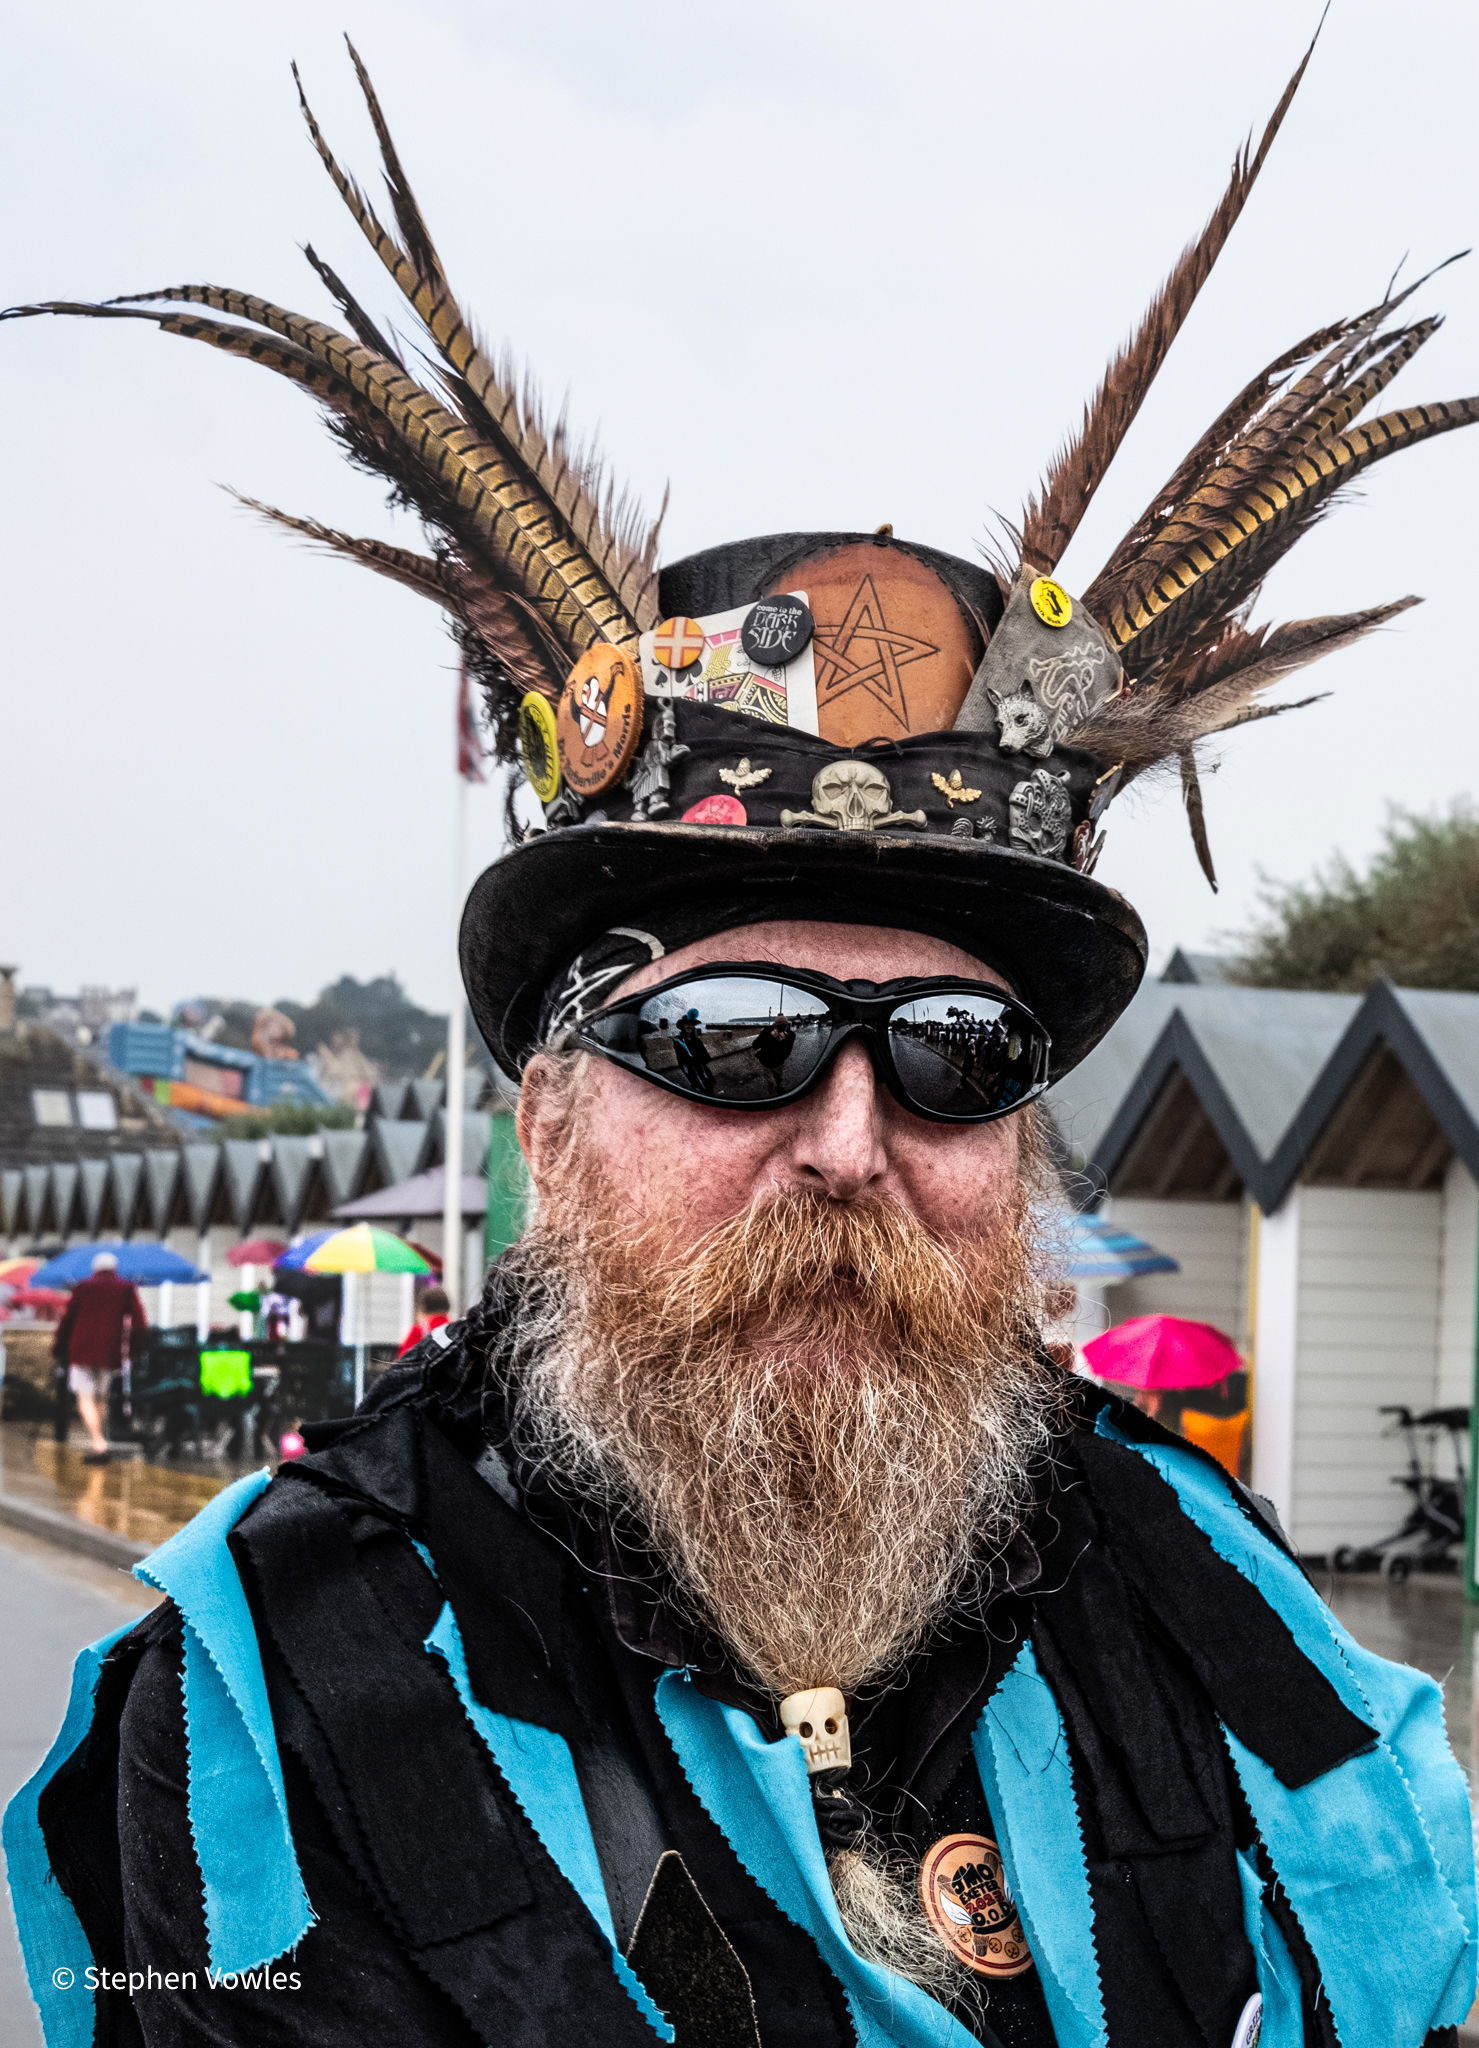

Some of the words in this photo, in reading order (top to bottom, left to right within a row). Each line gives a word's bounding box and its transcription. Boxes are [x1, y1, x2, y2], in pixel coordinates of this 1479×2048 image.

[752, 611, 798, 630] DARK
[788, 607, 803, 615] the
[748, 626, 797, 653] SIDE
[613, 703, 631, 759] Morris
[952, 1862, 994, 1895] JMO
[959, 1879, 999, 1906] EXETER
